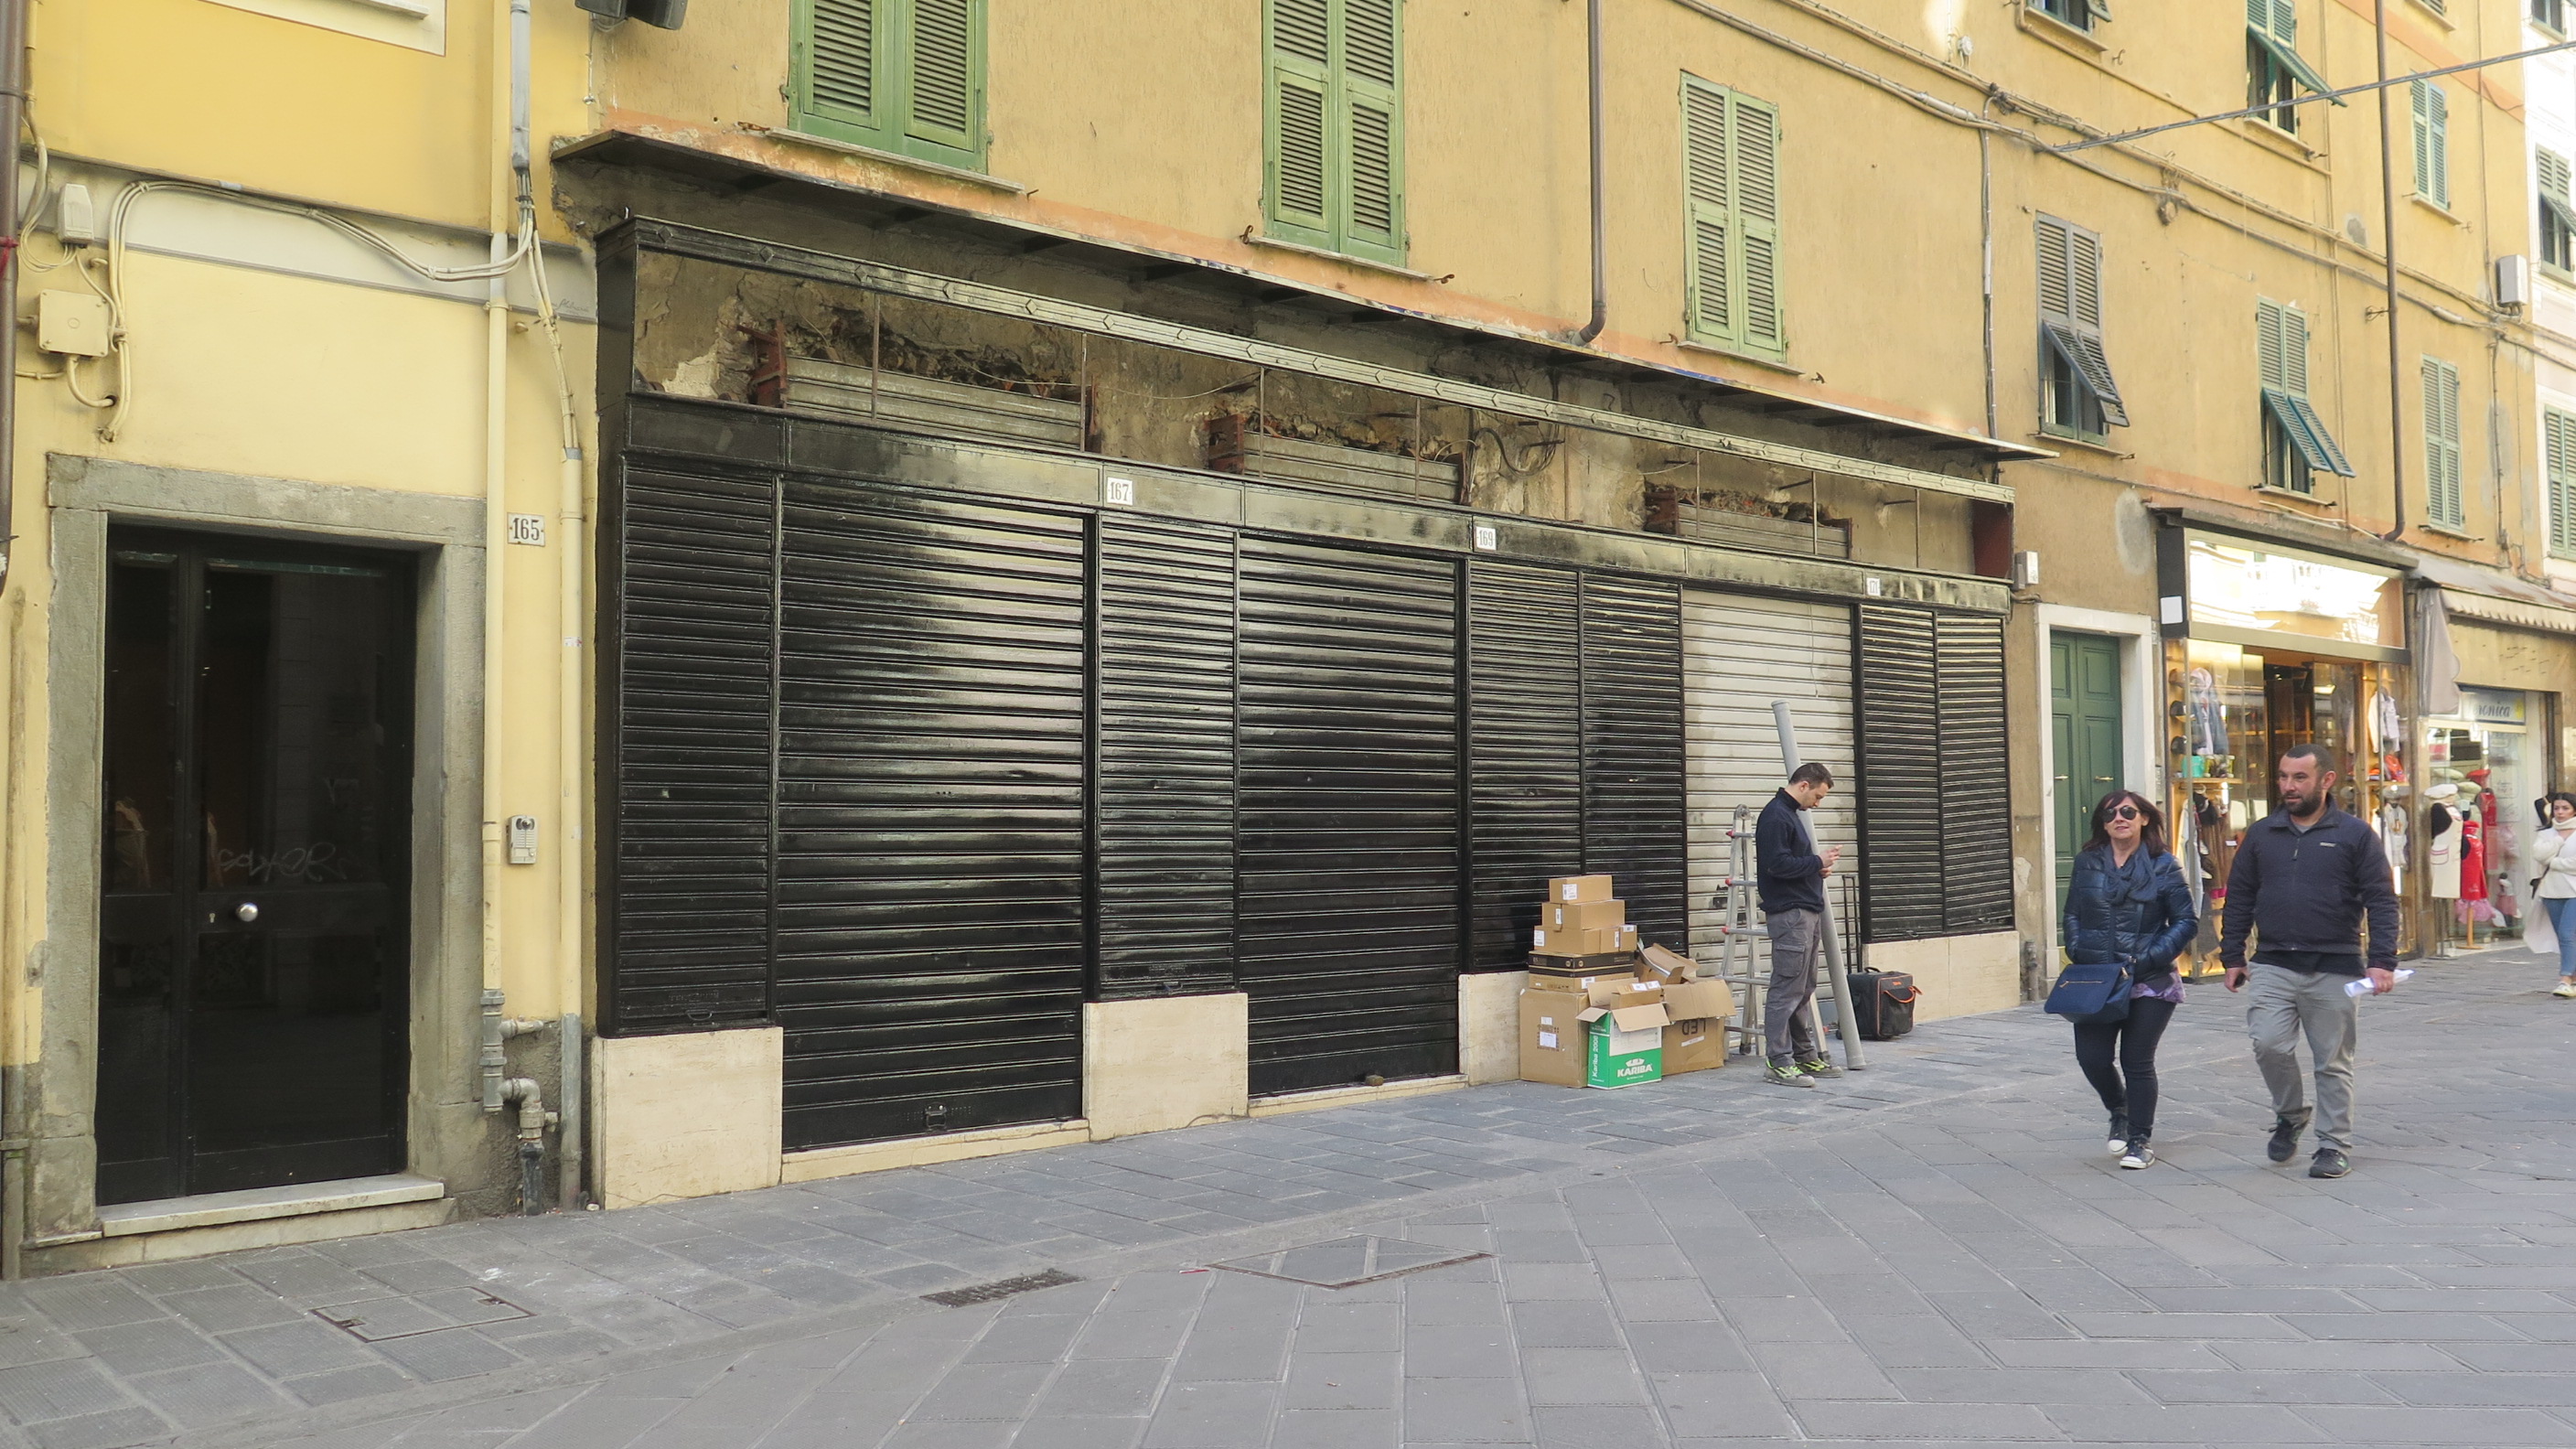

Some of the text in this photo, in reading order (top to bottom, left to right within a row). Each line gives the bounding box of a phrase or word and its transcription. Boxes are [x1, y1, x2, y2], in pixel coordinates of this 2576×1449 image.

[1111, 481, 1130, 501] 167
[512, 517, 540, 541] 165
[1479, 530, 1494, 547] 169
[1616, 1064, 1653, 1079] KARIBA
